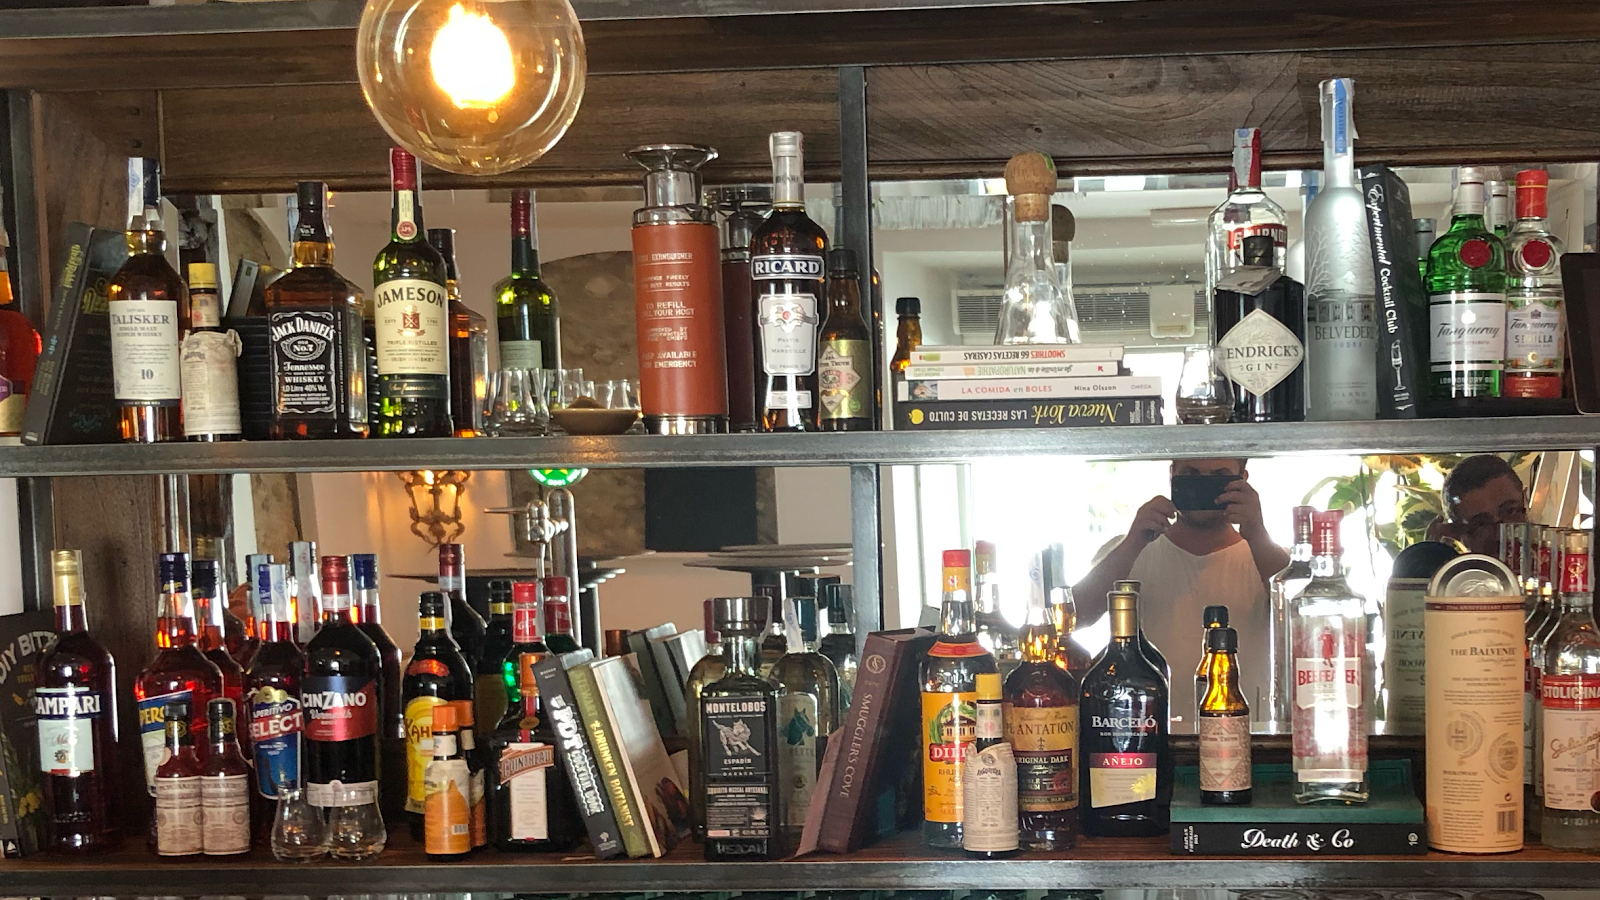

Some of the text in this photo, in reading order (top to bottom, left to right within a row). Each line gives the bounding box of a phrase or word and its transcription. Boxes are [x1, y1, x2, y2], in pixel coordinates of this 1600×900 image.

[755, 261, 819, 274] RICARD
[1380, 268, 1395, 308] Cocktail
[377, 287, 445, 308] JAMESON
[657, 301, 686, 309] REFILL
[112, 314, 169, 324] TALISKER
[1386, 310, 1399, 334] Club
[271, 317, 336, 342] JACK DANIEL'S
[1437, 322, 1500, 339] Tanqueray
[963, 350, 1066, 360] SMOOTHIES 66 RECETAS CASERAS
[283, 361, 325, 371] Tennessee
[977, 366, 1026, 376] NATUROPATHIE
[1246, 363, 1273, 372] GIN
[141, 369, 154, 380] 10
[962, 386, 973, 394] LA
[975, 386, 1011, 394] COMIDA
[1025, 385, 1053, 393] BOLES
[1092, 384, 1117, 392] Olsson
[929, 402, 1122, 425] Nueva York LAS RECETAS DE CULTO
[0, 642, 17, 685] DIY
[1298, 669, 1360, 686] BEEFEAER
[1543, 686, 1600, 699] STOLICHNA
[34, 694, 101, 715] AMPARI
[302, 691, 367, 710] CINZANO
[705, 701, 766, 714] MONTELOBOS
[553, 706, 583, 750] PDT
[1006, 721, 1075, 735] PLANTATION
[1092, 715, 1157, 729] BARCELÓ
[404, 718, 433, 744] KAH
[840, 693, 873, 797] SMUGGLER'S COVE
[502, 750, 552, 778] COINTREAU
[1050, 756, 1069, 764] DARK
[1102, 755, 1143, 766] AÑEJO
[594, 729, 634, 826] DRUNKEN BOTANIST
[1241, 828, 1354, 851] Death & Co
